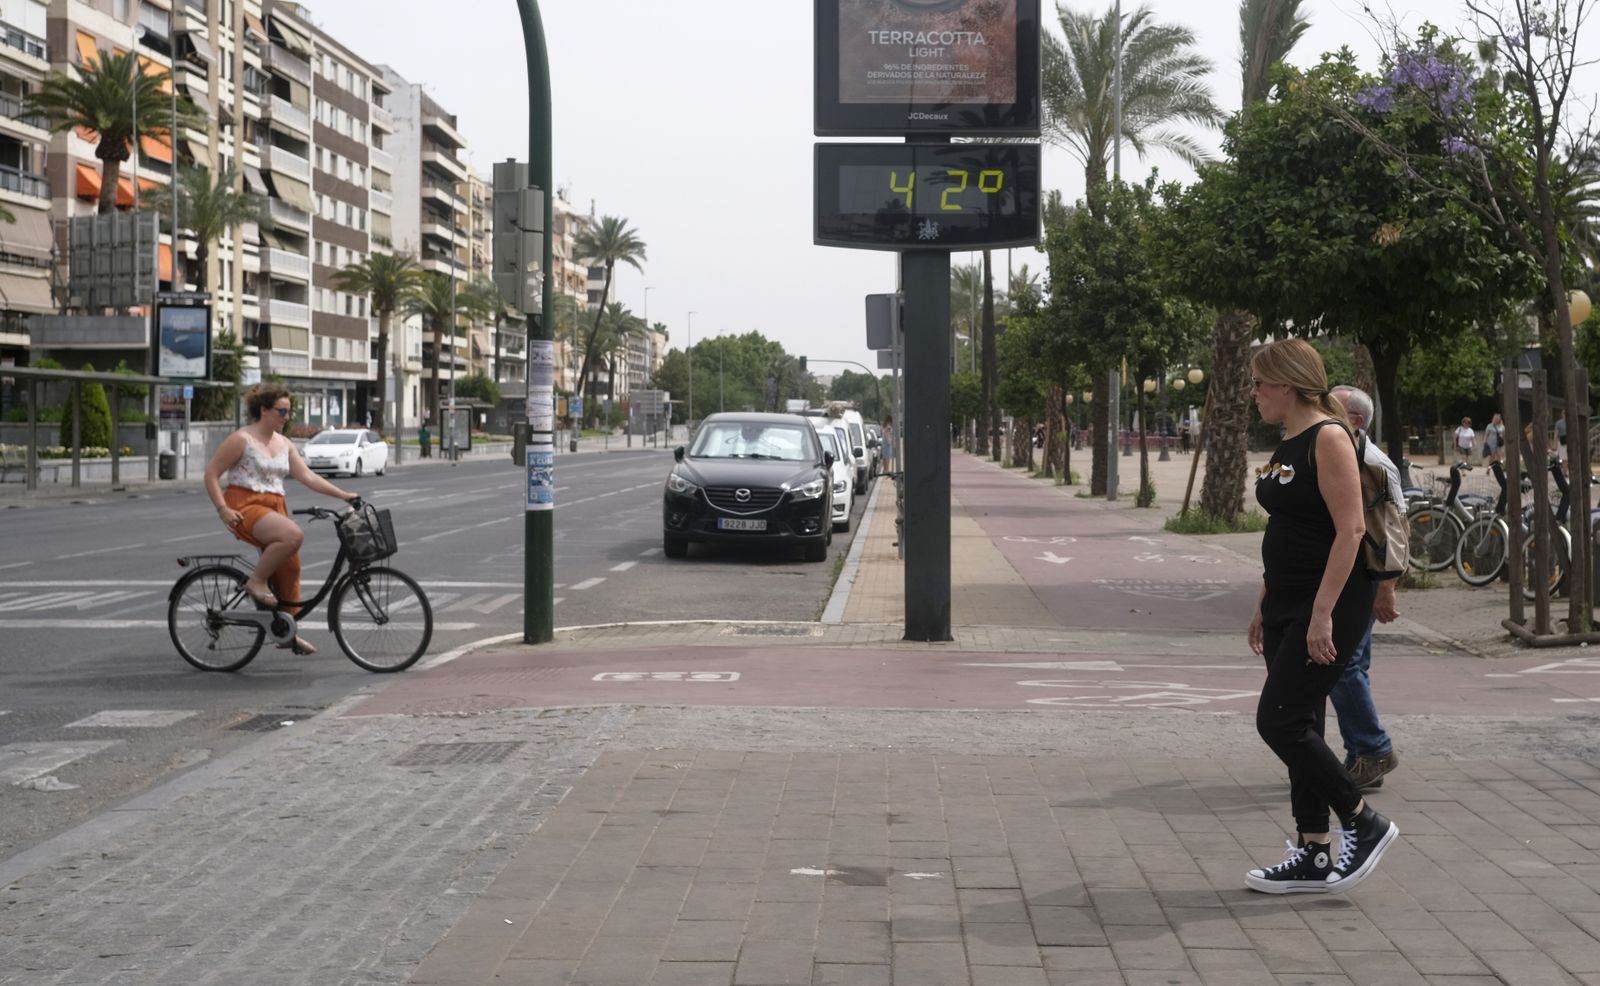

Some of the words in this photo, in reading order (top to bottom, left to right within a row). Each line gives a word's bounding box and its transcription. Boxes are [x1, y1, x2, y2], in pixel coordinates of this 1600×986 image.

[868, 31, 985, 45] TERRACOTTA
[909, 47, 945, 57] LIGHT
[867, 71, 913, 79] DERIVADOS
[913, 71, 925, 79] DE
[925, 71, 935, 79] LA
[908, 112, 949, 120] JCDecaux
